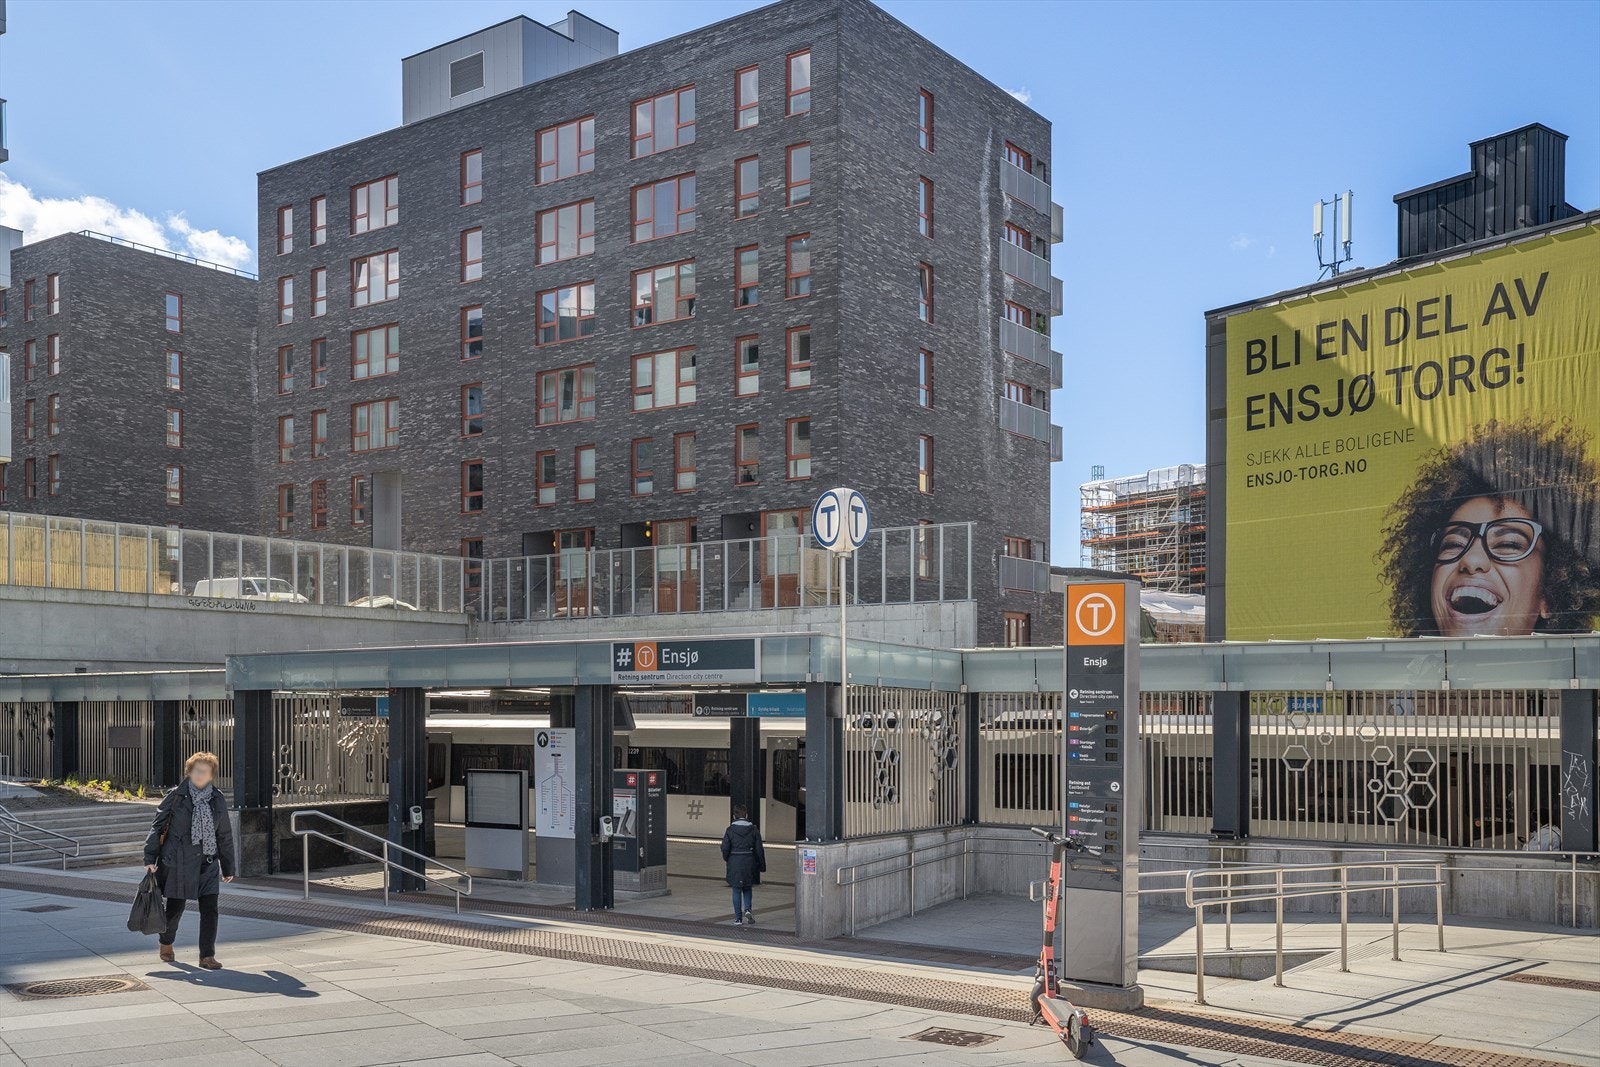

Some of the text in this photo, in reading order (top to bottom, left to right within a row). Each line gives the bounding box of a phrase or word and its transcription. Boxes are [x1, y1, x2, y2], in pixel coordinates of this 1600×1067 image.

[1246, 271, 1550, 376] BLI EN DEL AV
[1246, 342, 1525, 432] ENSJØ TORG!
[1246, 427, 1415, 467] SJEKK ALLE BOLIGENE
[1246, 458, 1368, 488] ENSJO-TORG.NO
[820, 504, 836, 538] T
[851, 504, 864, 538] T
[1086, 603, 1105, 631] T
[641, 650, 650, 665] T
[662, 647, 699, 668] Ensjø
[1083, 657, 1108, 668] Ensjø
[617, 672, 723, 682] Retning sentrum Direction city centre
